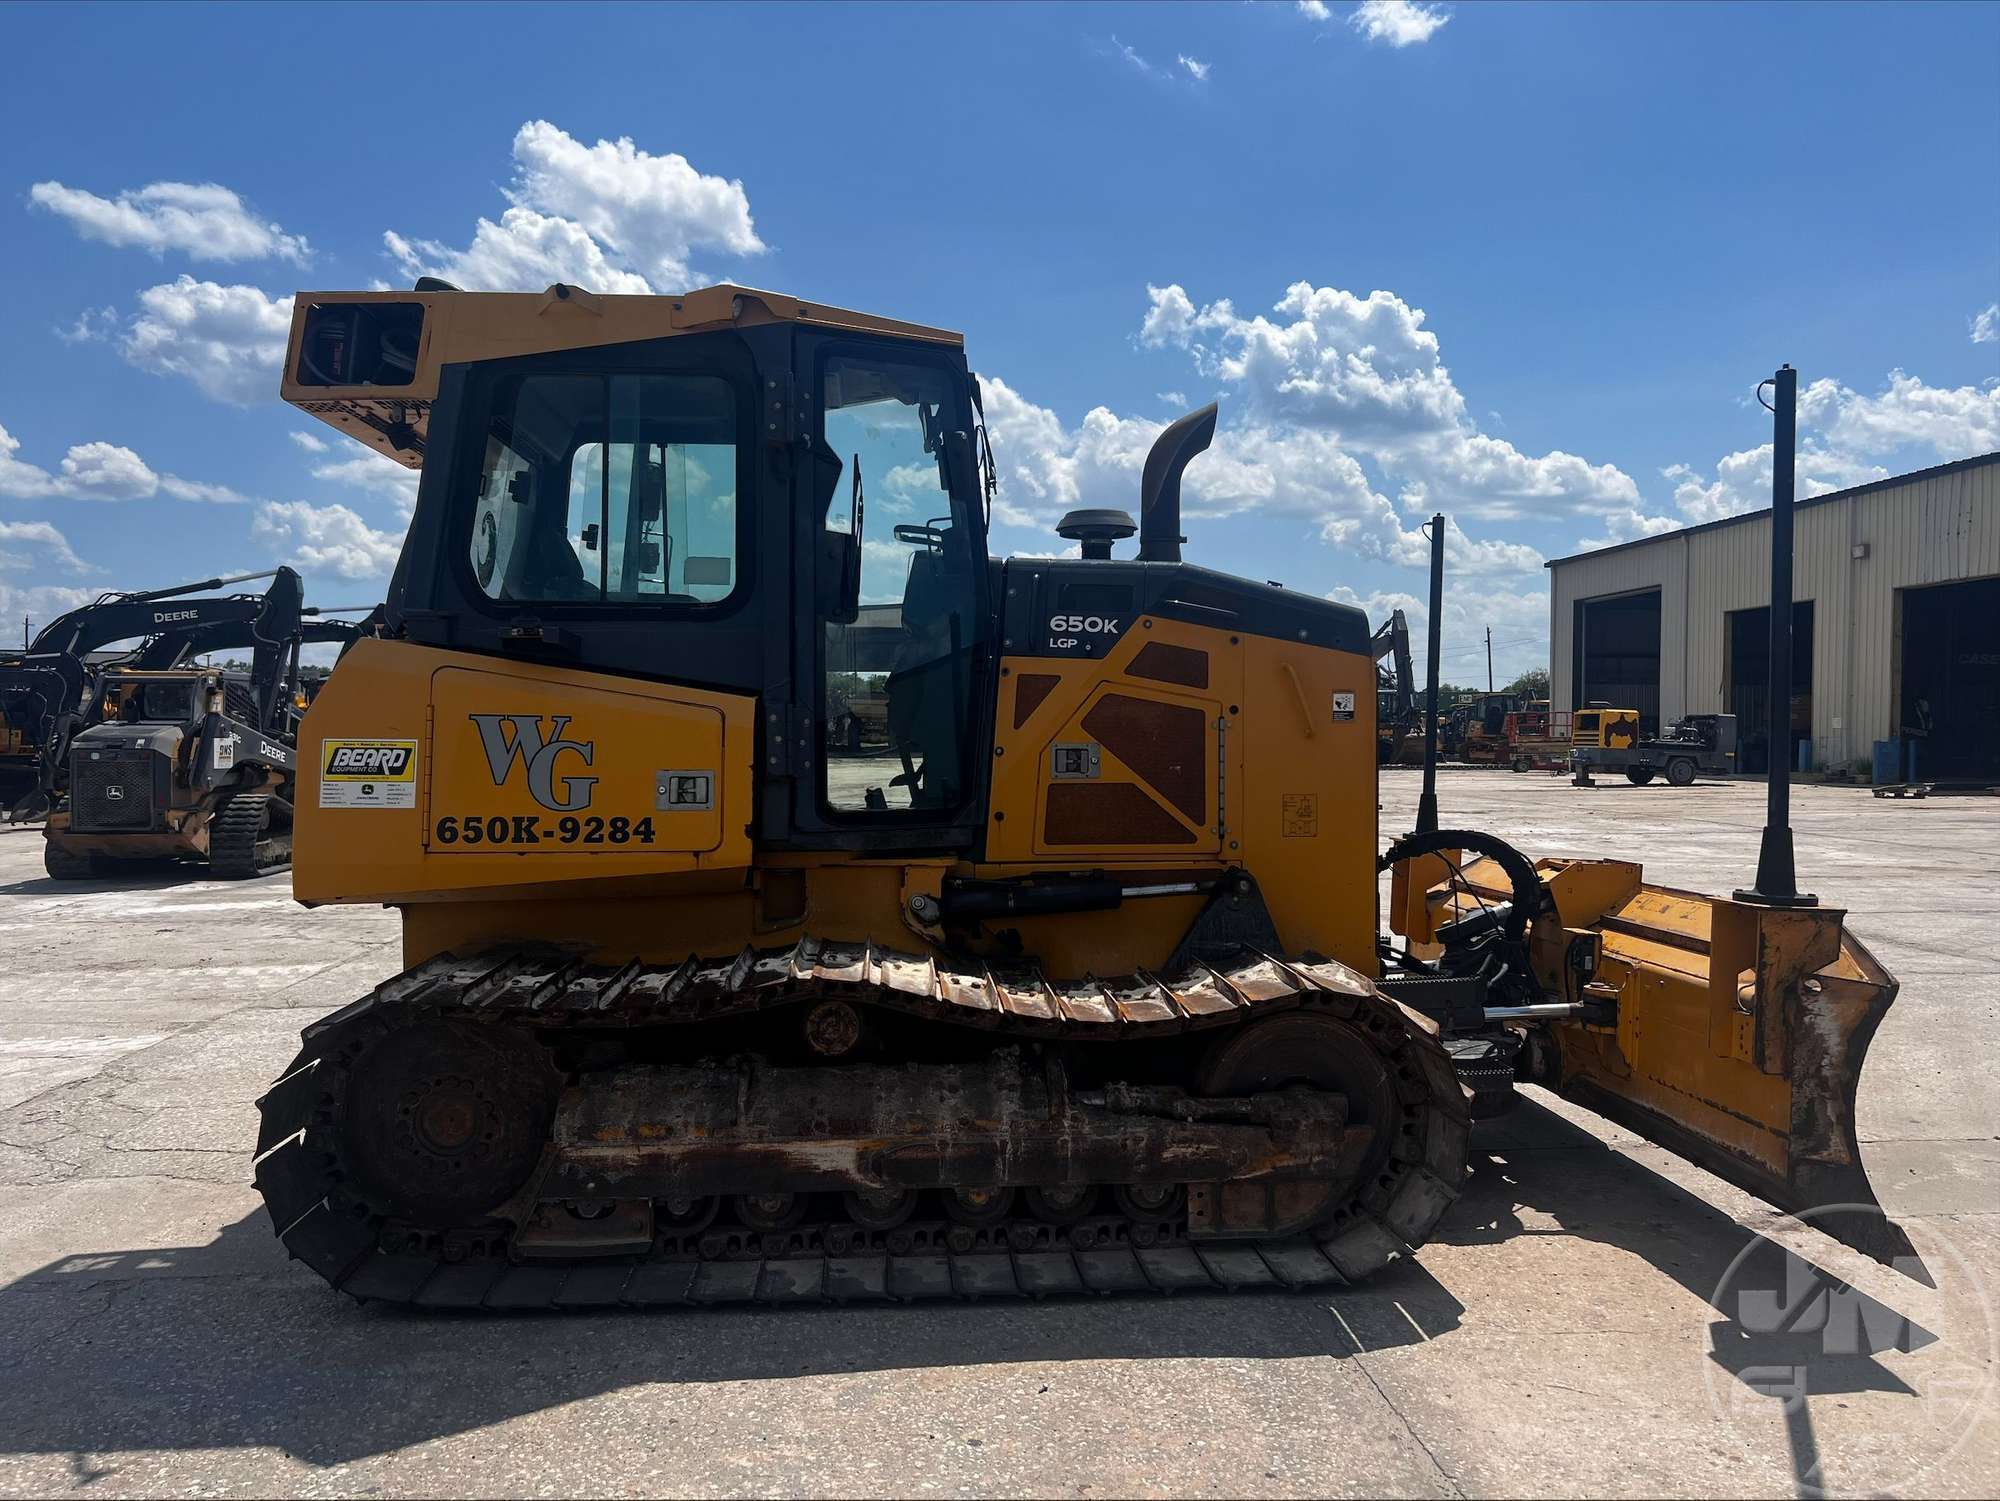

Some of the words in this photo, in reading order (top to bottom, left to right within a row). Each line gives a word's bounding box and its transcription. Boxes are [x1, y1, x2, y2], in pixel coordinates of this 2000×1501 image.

[153, 609, 199, 624] DEERE
[1049, 615, 1119, 634] 650K
[1049, 638, 1078, 648] LGP
[260, 740, 287, 763] DEERE
[333, 749, 406, 775] BEARD
[435, 816, 656, 845] 650K-9284
